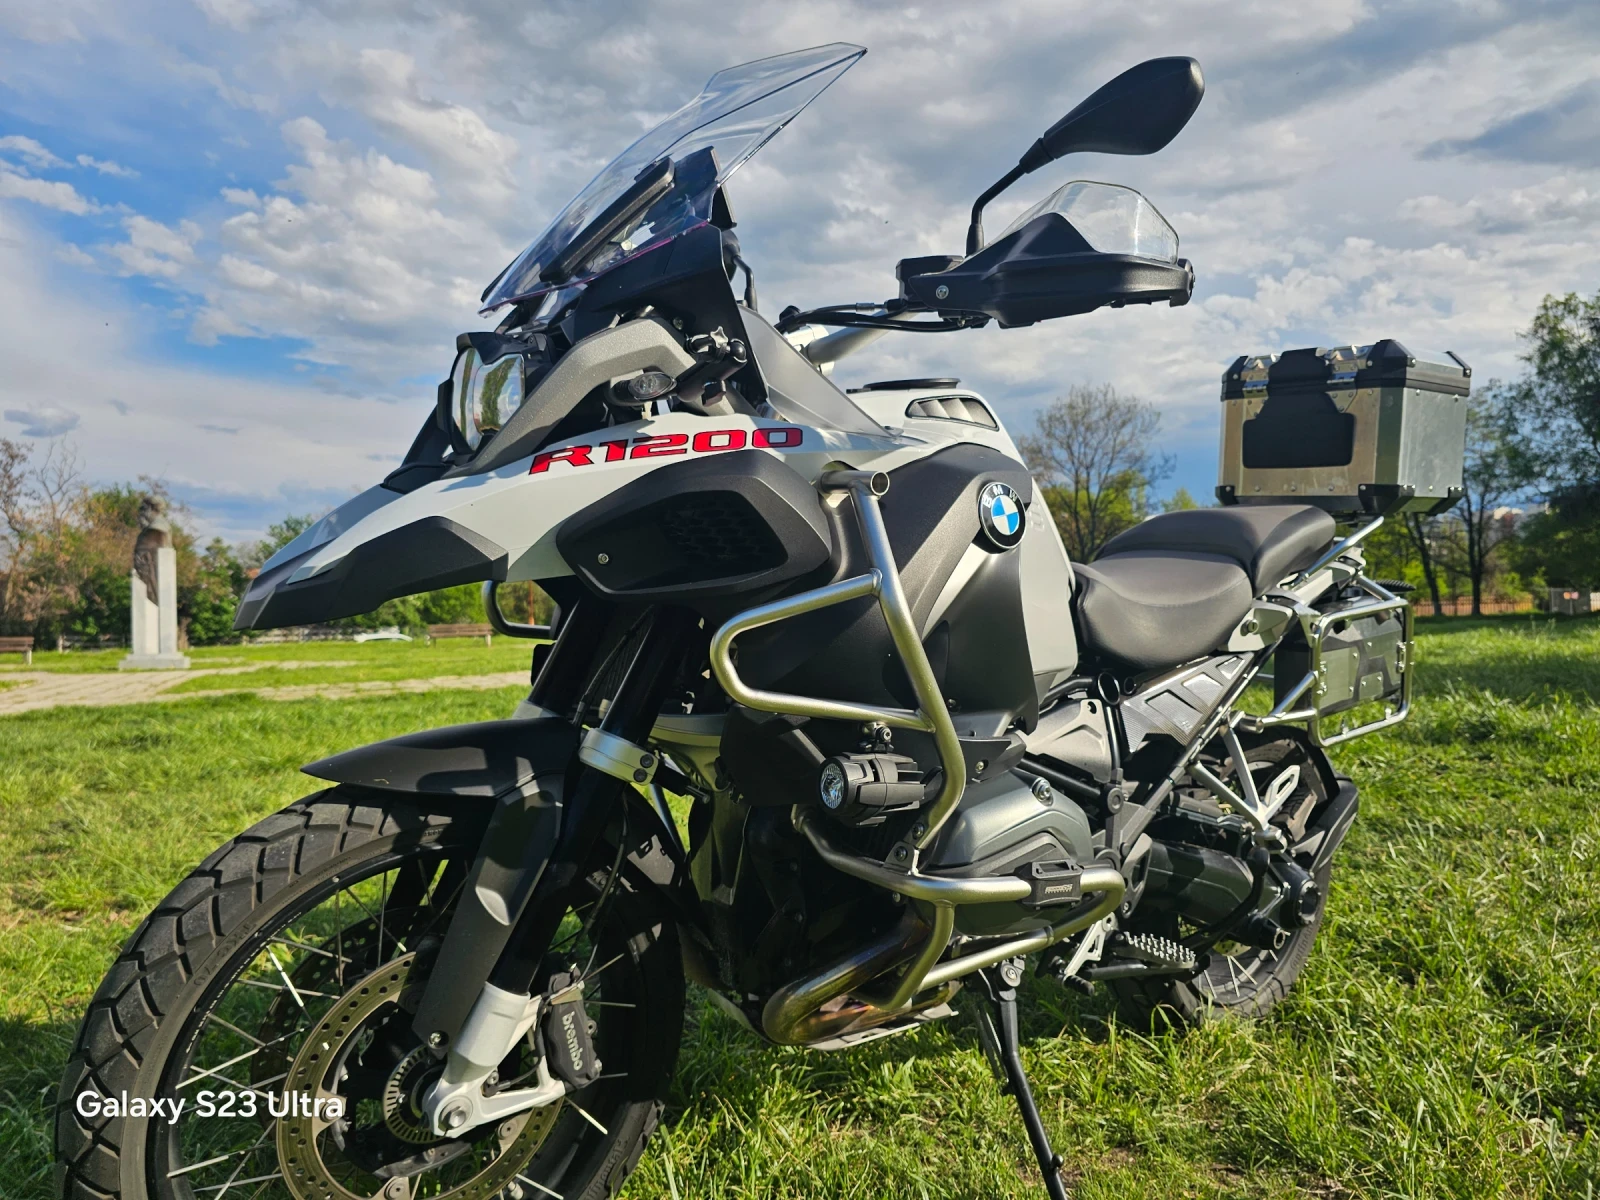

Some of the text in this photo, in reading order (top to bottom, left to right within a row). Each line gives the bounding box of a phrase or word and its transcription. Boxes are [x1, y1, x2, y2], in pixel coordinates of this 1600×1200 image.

[528, 427, 803, 475] R1200
[981, 484, 1018, 508] BMW
[562, 1011, 583, 1071] brembo
